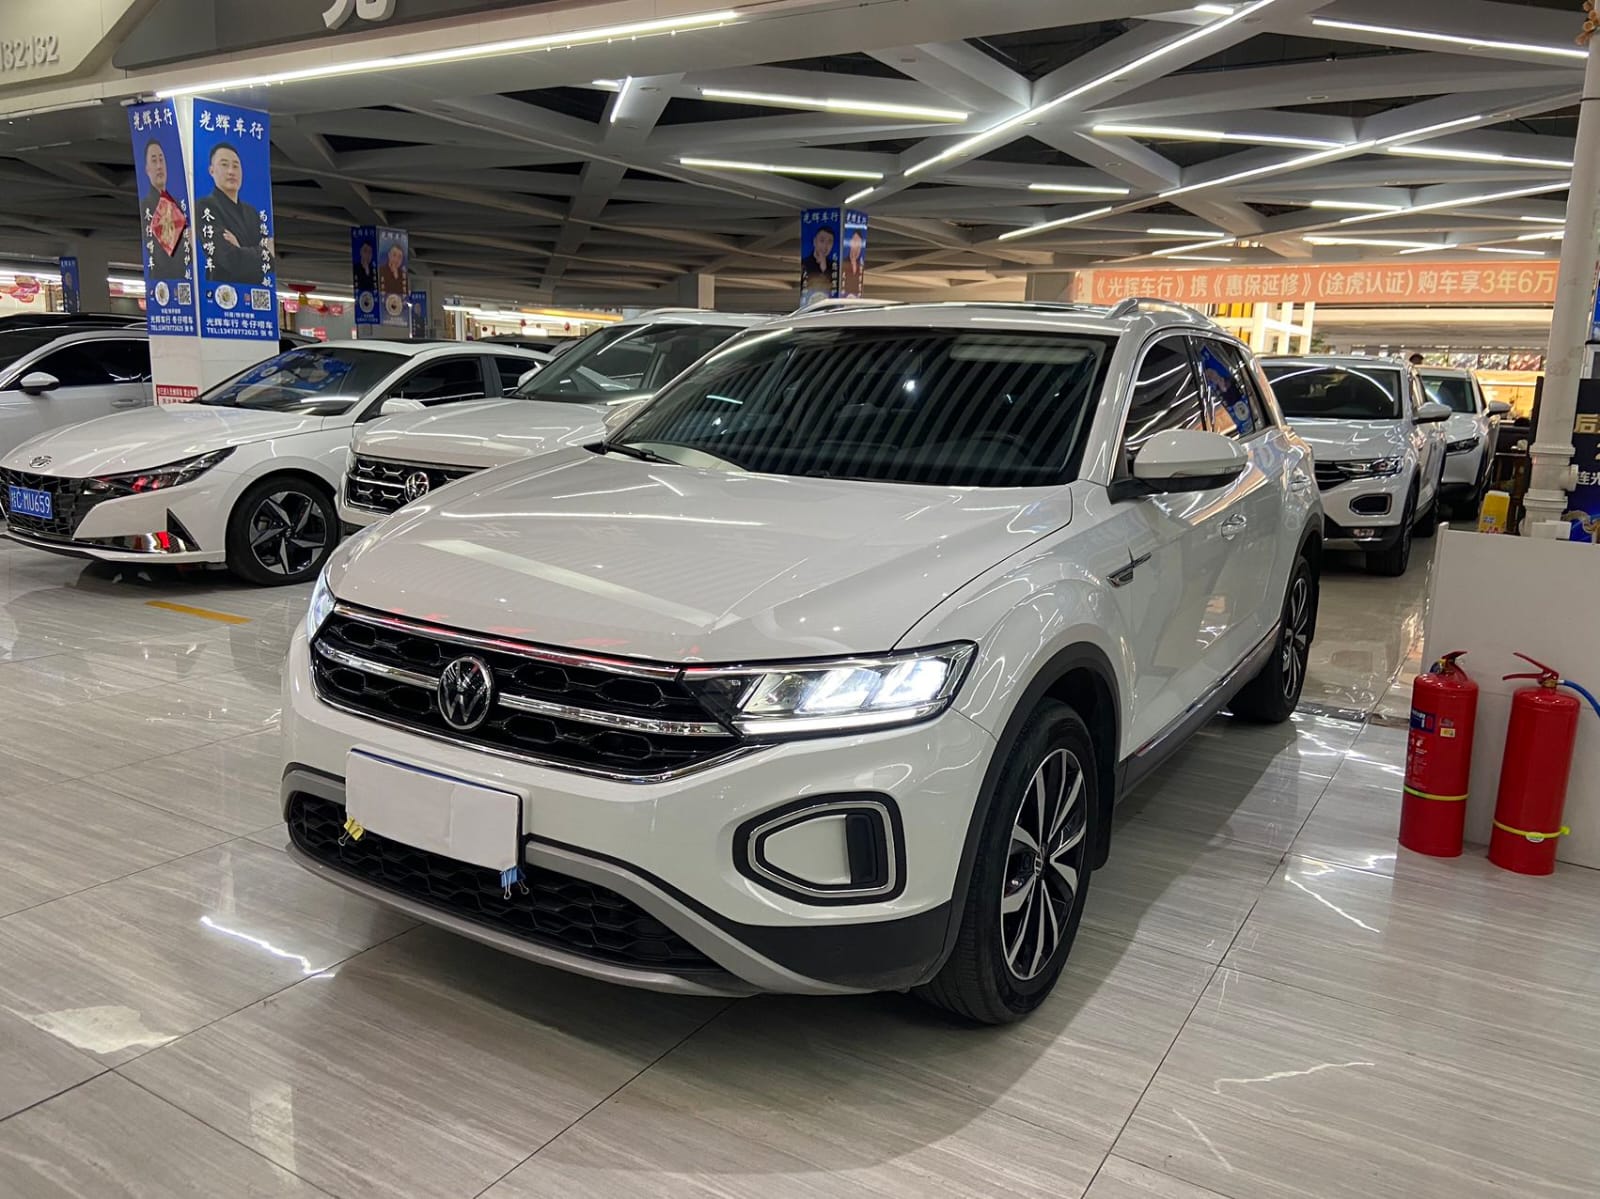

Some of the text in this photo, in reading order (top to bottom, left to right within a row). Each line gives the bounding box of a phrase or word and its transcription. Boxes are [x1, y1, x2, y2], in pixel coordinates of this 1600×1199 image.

[133, 108, 173, 131] 光辉车行
[199, 110, 265, 140] 光辉车行
